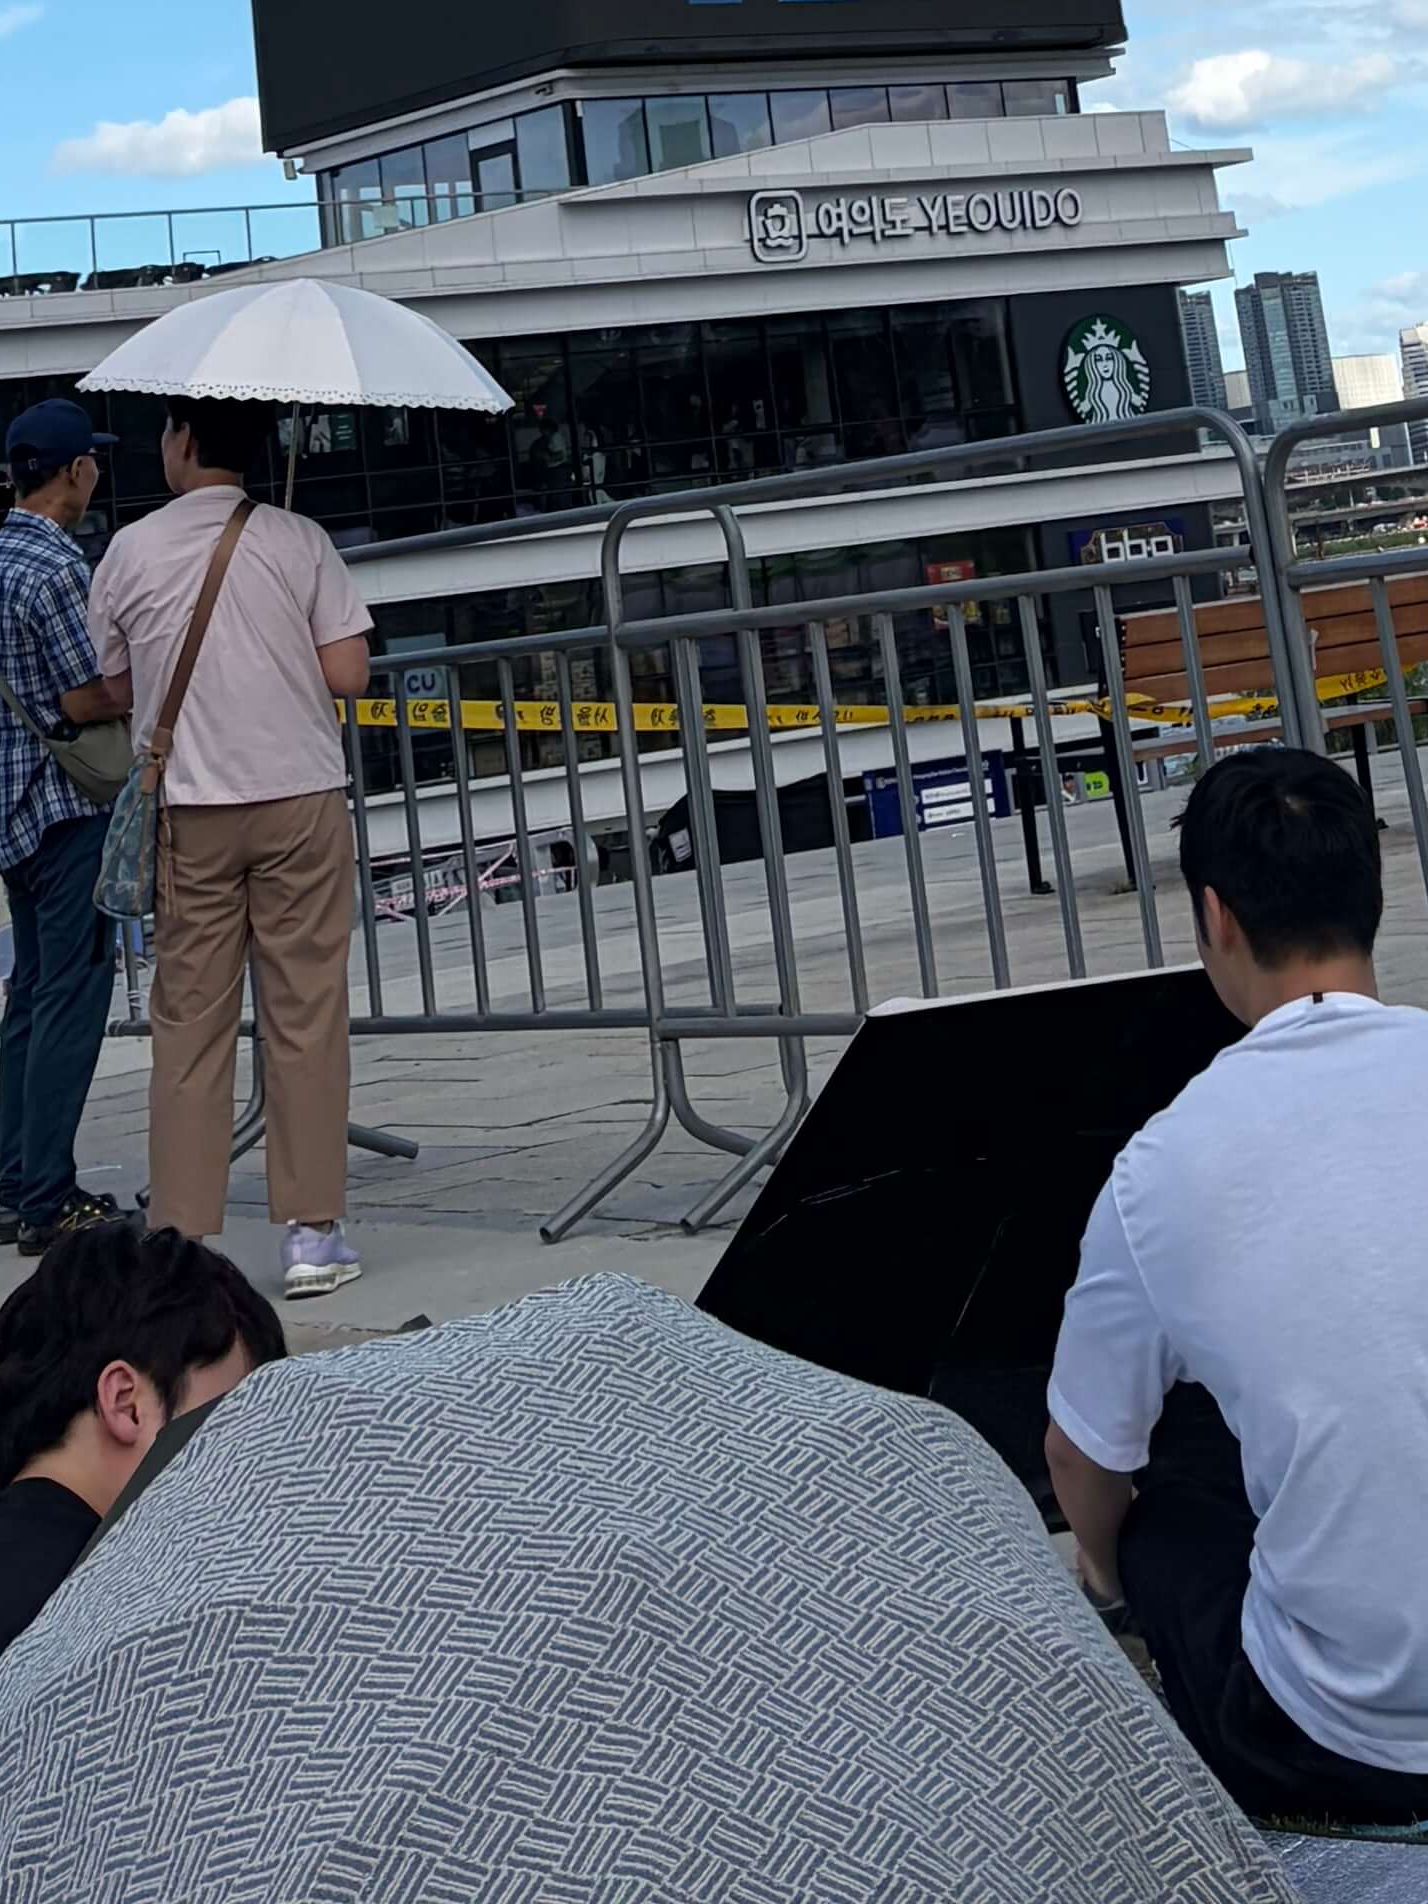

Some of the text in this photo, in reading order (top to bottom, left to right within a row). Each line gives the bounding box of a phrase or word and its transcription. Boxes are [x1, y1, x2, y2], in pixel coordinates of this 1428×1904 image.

[816, 187, 1084, 246] 여의도 YEOUIDO
[406, 673, 435, 693] CU
